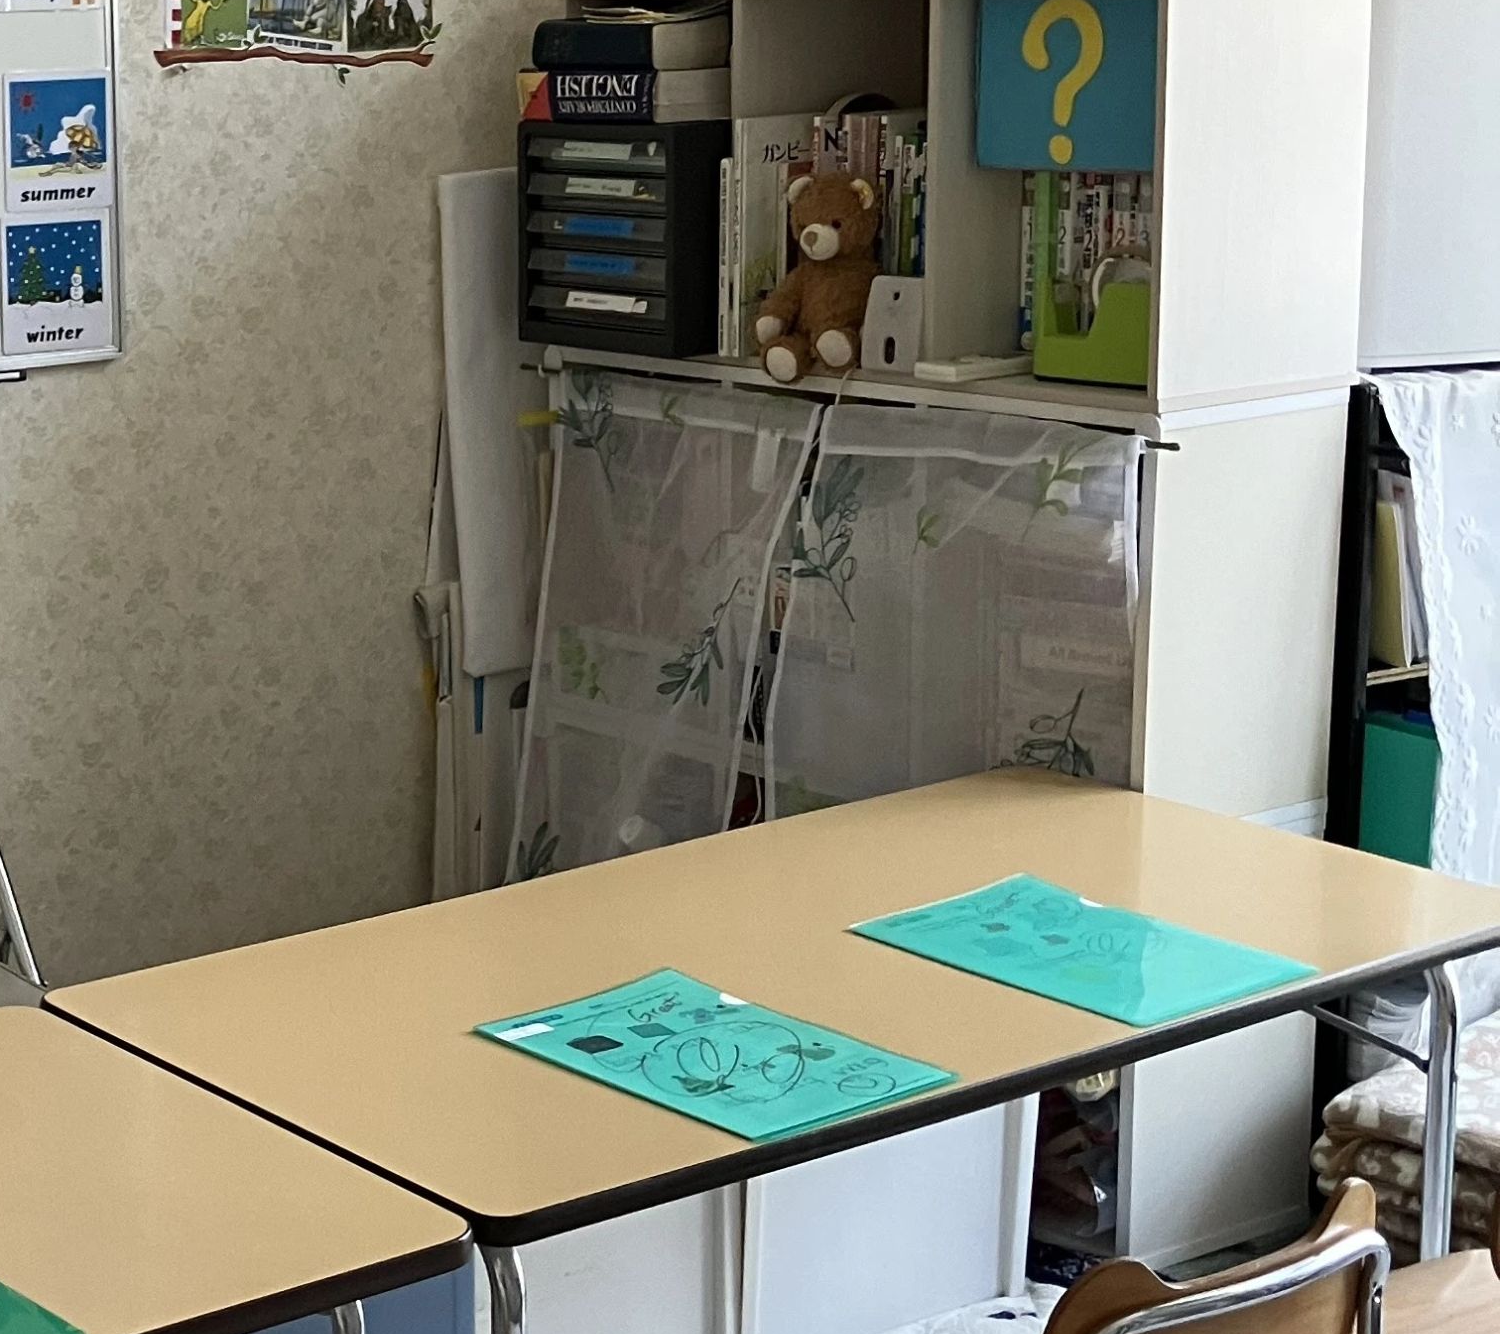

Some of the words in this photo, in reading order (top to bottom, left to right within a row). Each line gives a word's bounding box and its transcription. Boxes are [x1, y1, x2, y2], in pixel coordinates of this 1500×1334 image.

[556, 74, 640, 98] ENGLISH
[20, 186, 96, 203] summer
[26, 324, 84, 343] winter
